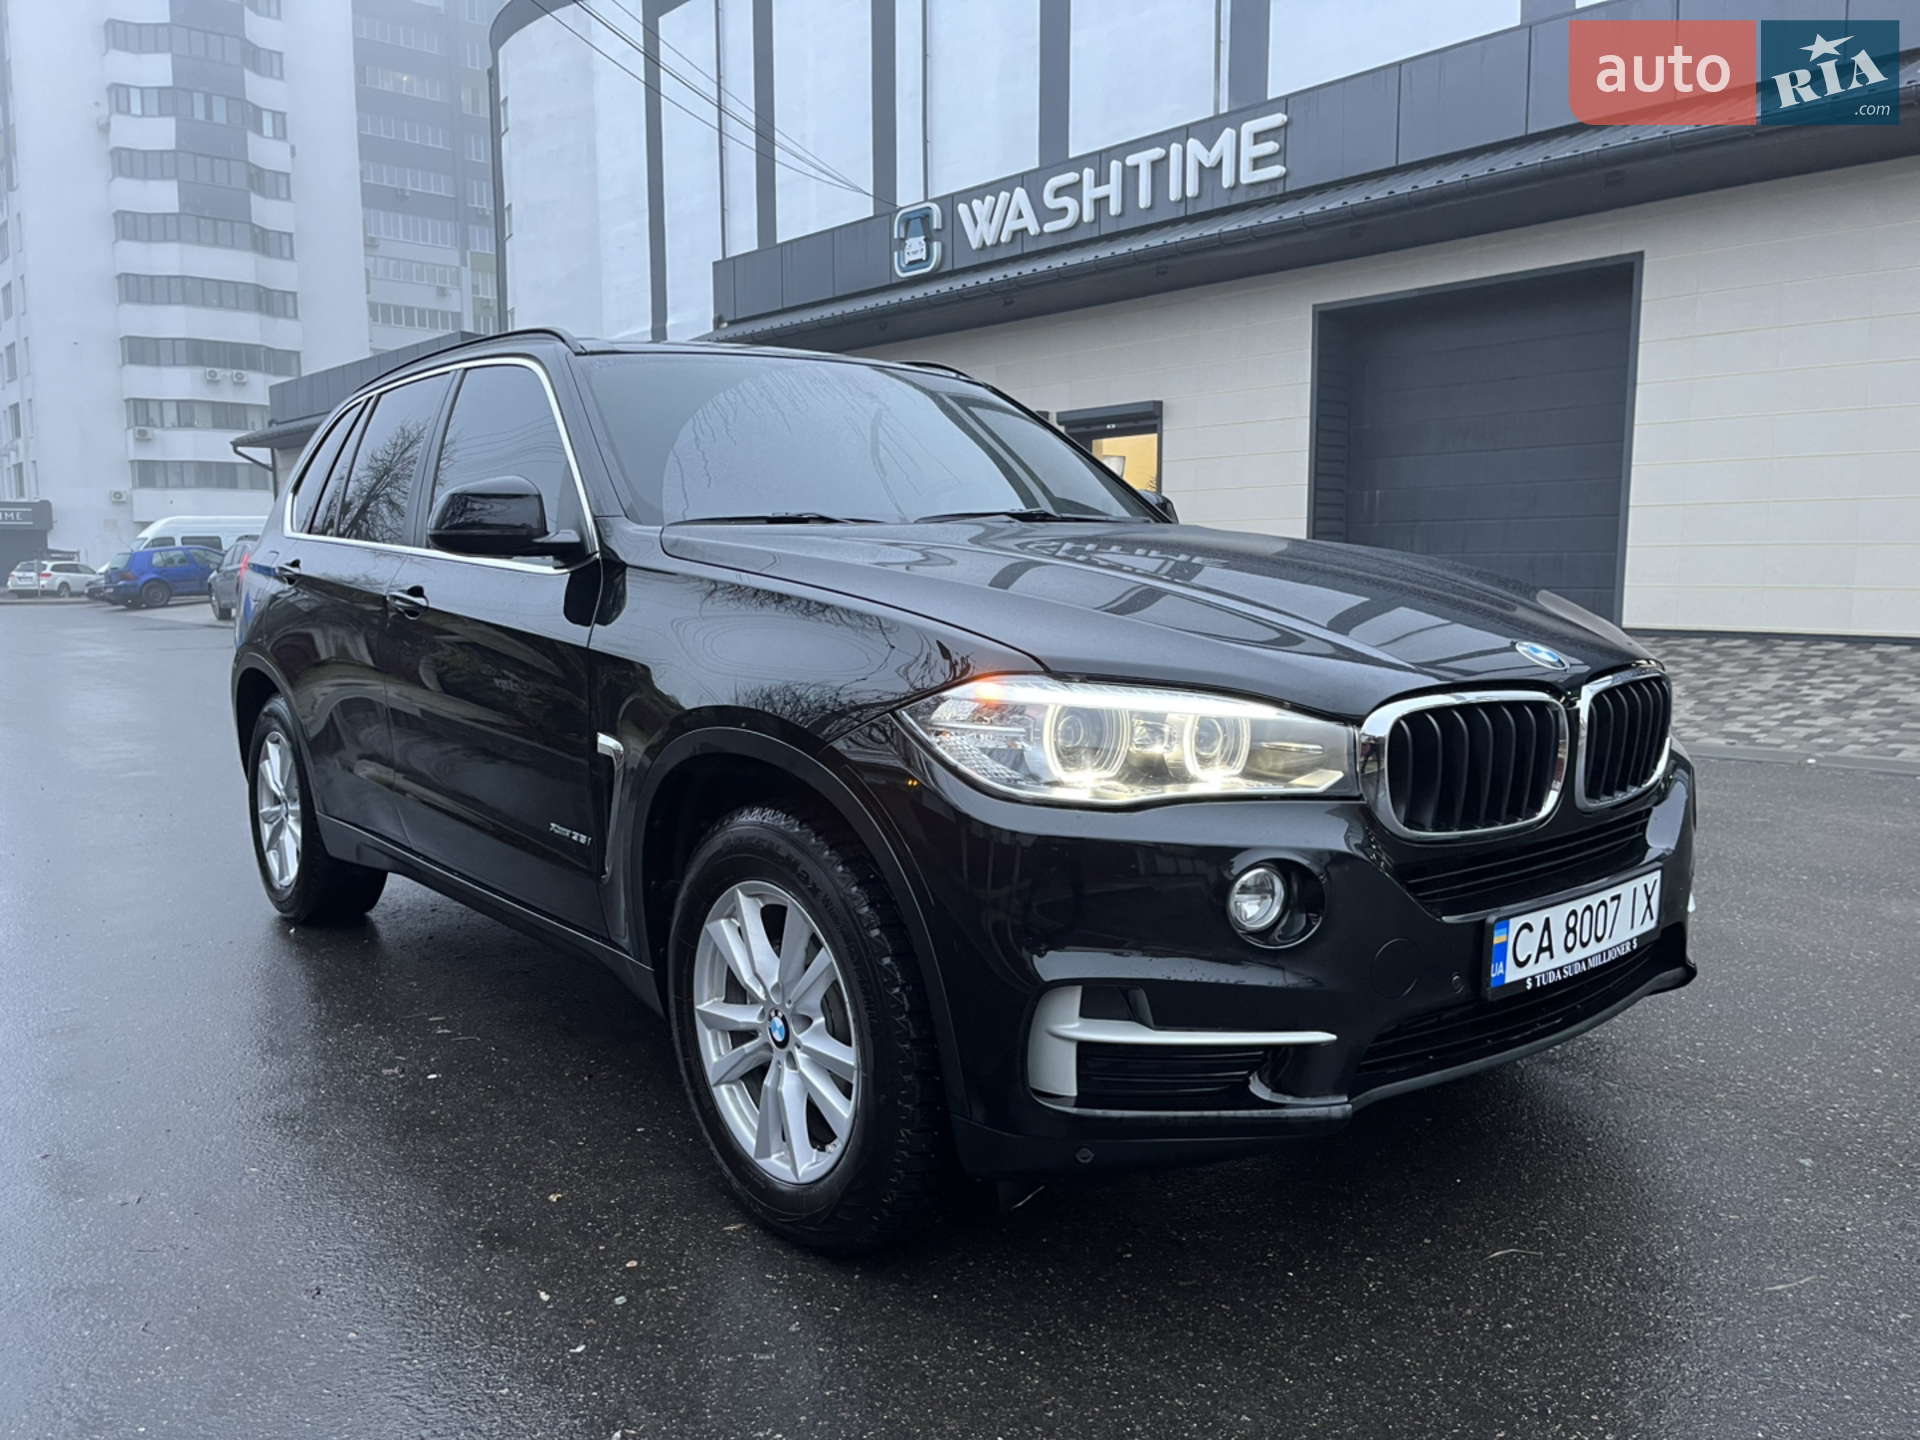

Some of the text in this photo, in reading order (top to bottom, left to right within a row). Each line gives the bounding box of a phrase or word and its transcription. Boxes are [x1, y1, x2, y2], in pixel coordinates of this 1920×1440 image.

[957, 112, 1289, 251] WASHTIME
[1511, 879, 1658, 969] CA 8007 IX
[1490, 961, 1505, 978] UA
[1535, 969, 1563, 987] TUDA
[1562, 961, 1587, 979] SUDA
